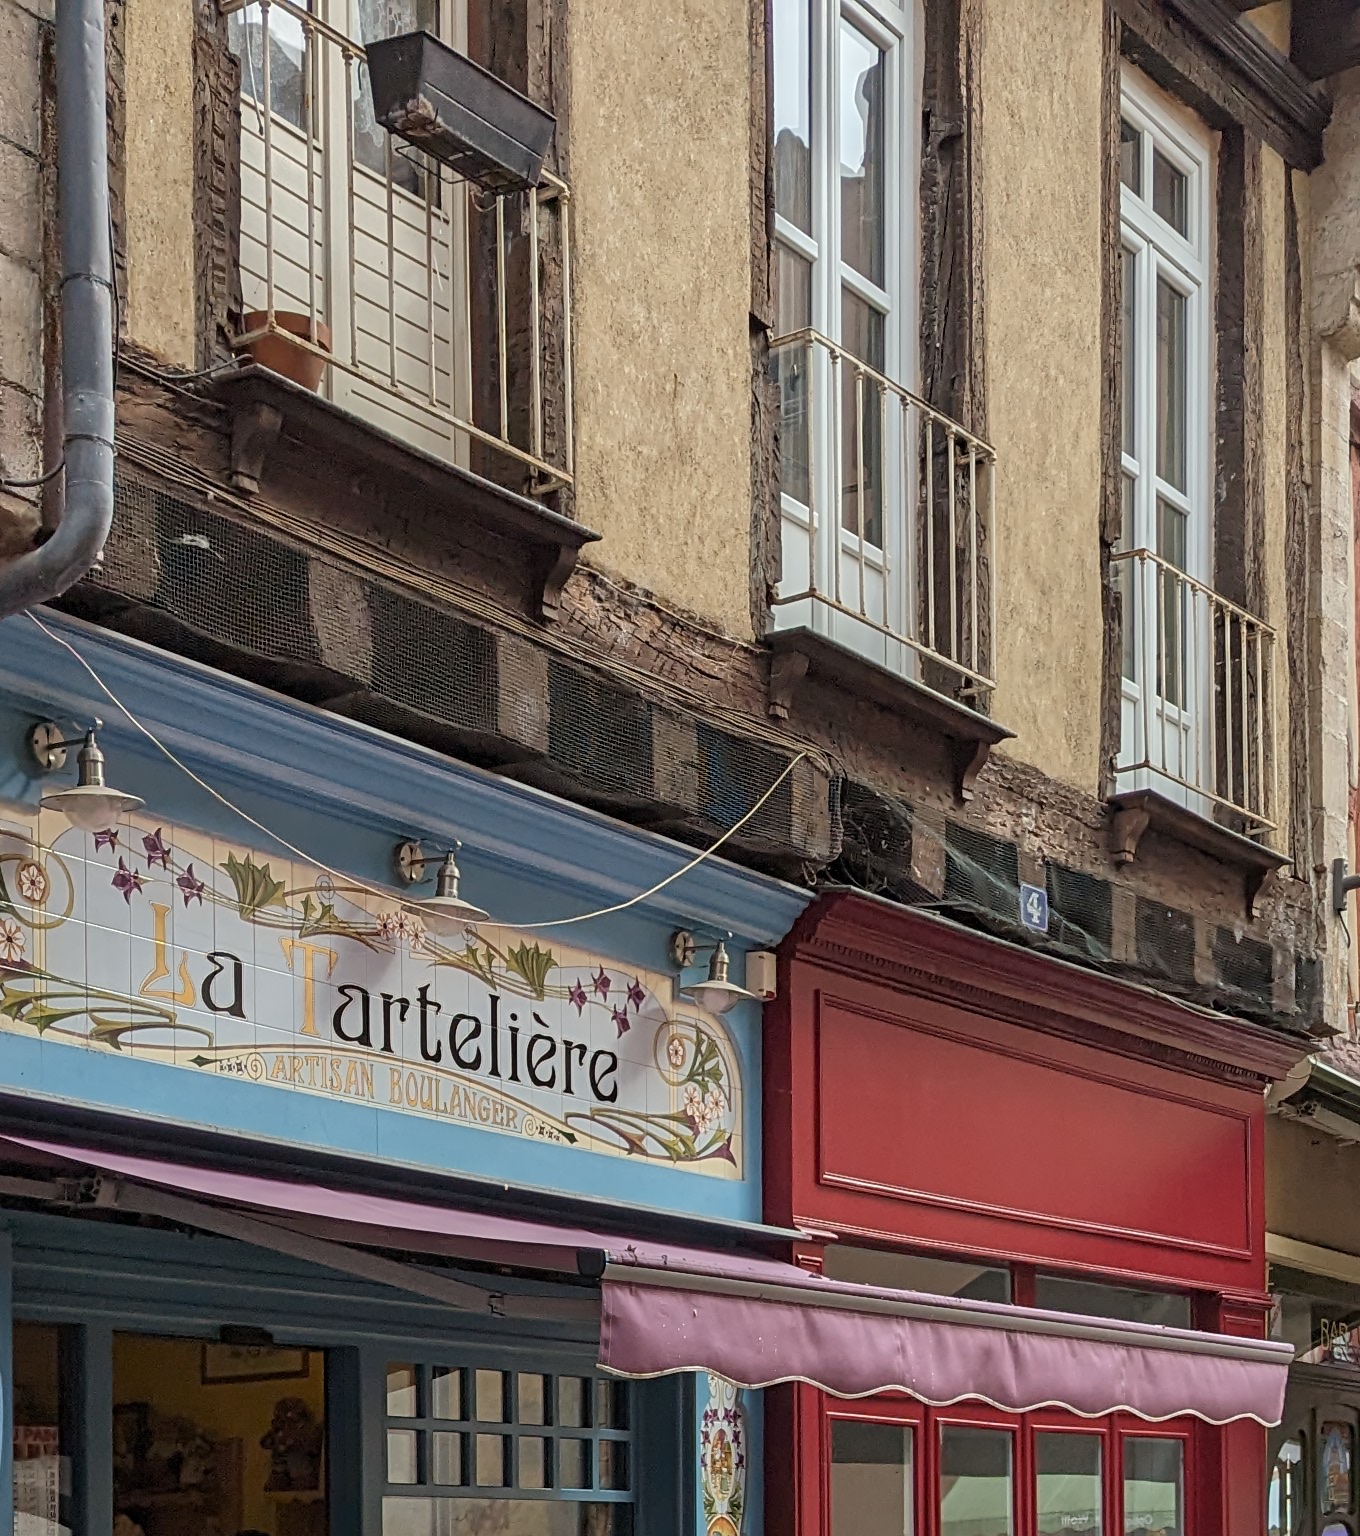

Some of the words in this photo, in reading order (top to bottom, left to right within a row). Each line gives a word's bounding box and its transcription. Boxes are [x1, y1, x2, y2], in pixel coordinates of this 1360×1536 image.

[1027, 892, 1042, 923] 4
[139, 901, 247, 1019] La
[278, 937, 618, 1103] Tartelière
[270, 1053, 375, 1099] ARTISAN
[390, 1070, 518, 1129] BOULANGER
[1321, 1318, 1348, 1352] BAR
